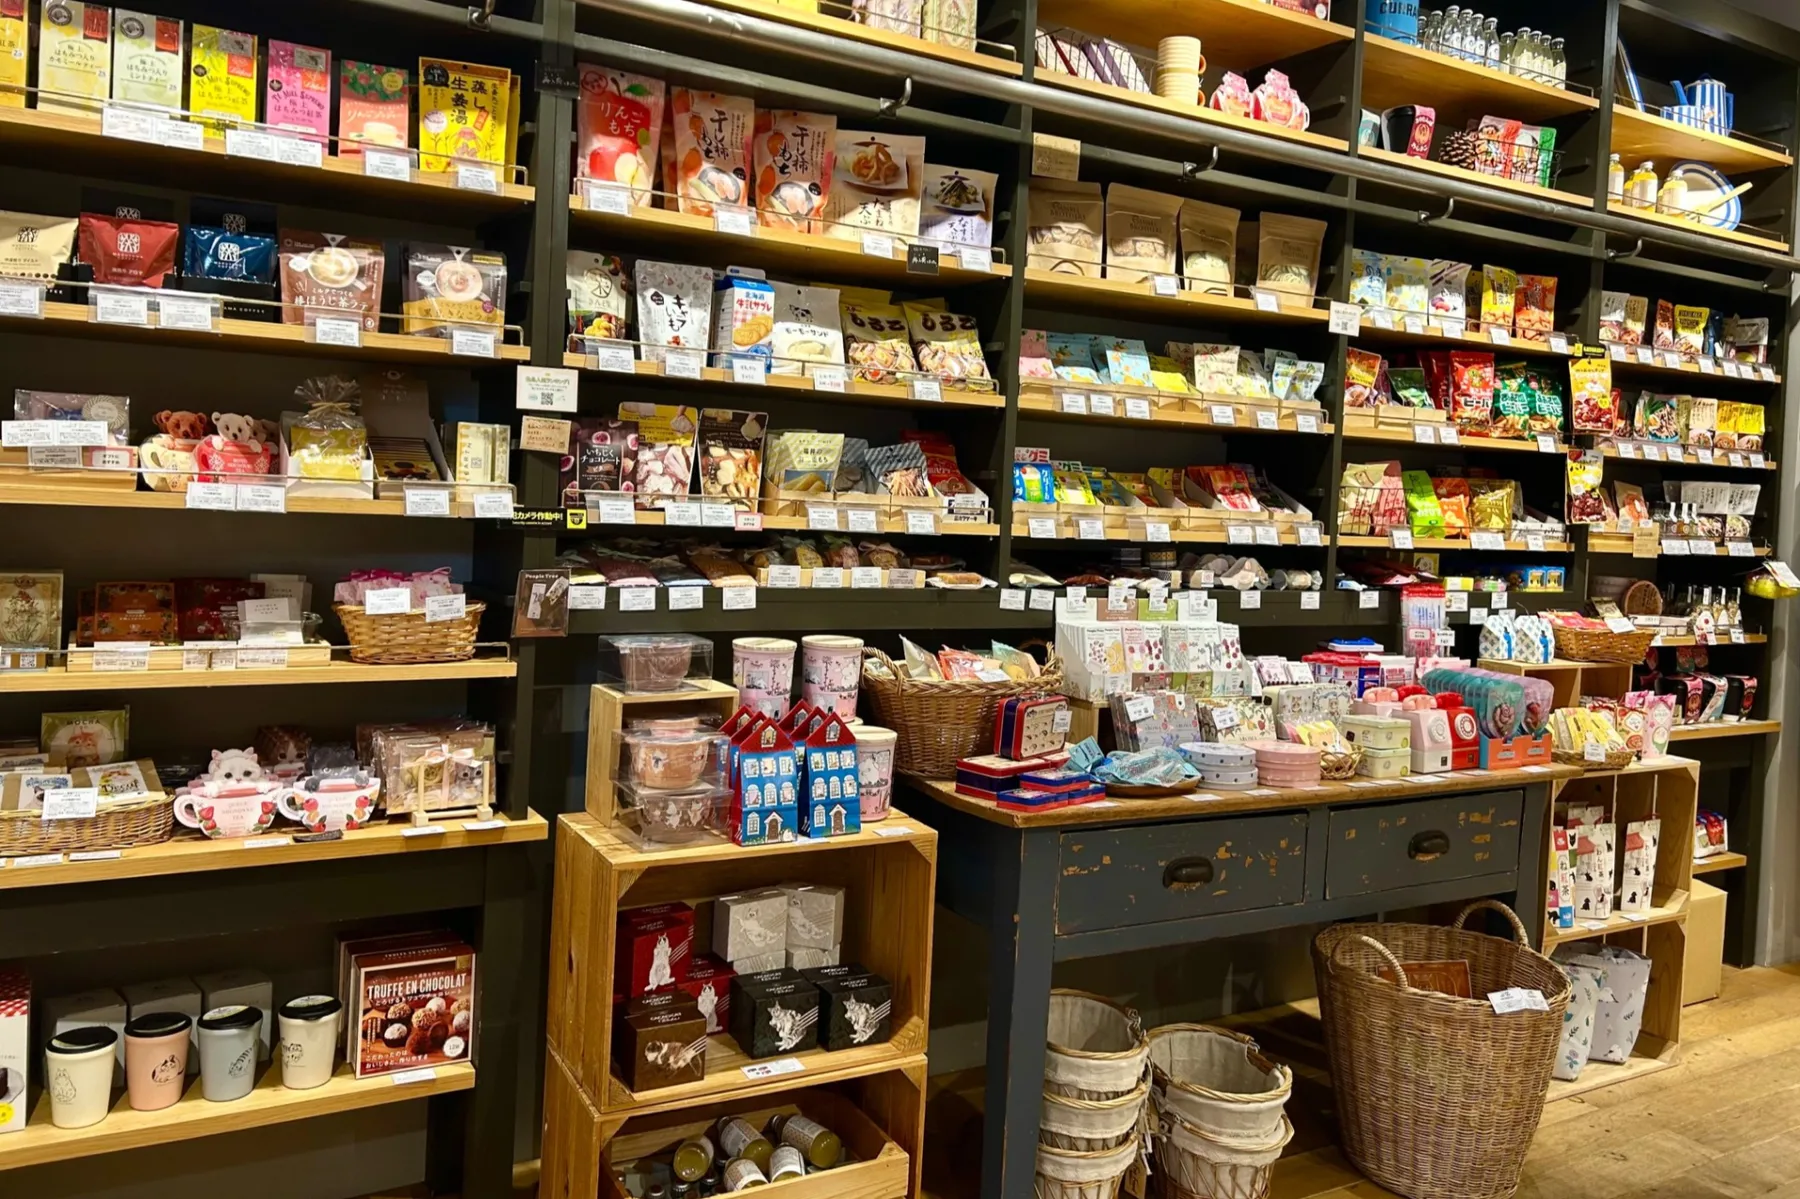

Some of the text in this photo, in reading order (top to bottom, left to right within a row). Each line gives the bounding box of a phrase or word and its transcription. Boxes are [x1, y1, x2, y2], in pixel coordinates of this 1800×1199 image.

[54, 49, 95, 61] はちみつ入り
[126, 64, 168, 76] はちみつ入り
[450, 76, 470, 126] 生姜湯
[600, 101, 645, 125] りんご
[608, 117, 637, 138] もち
[791, 124, 810, 175] 干し柿
[736, 298, 773, 312] 牛乳サブレ
[785, 326, 829, 338] モーモーサンド
[586, 448, 614, 457] いちじく
[1029, 450, 1048, 462] グミ
[581, 456, 620, 466] チョコレート
[367, 973, 467, 1000] TRUFFE EN CHOCOLAT
